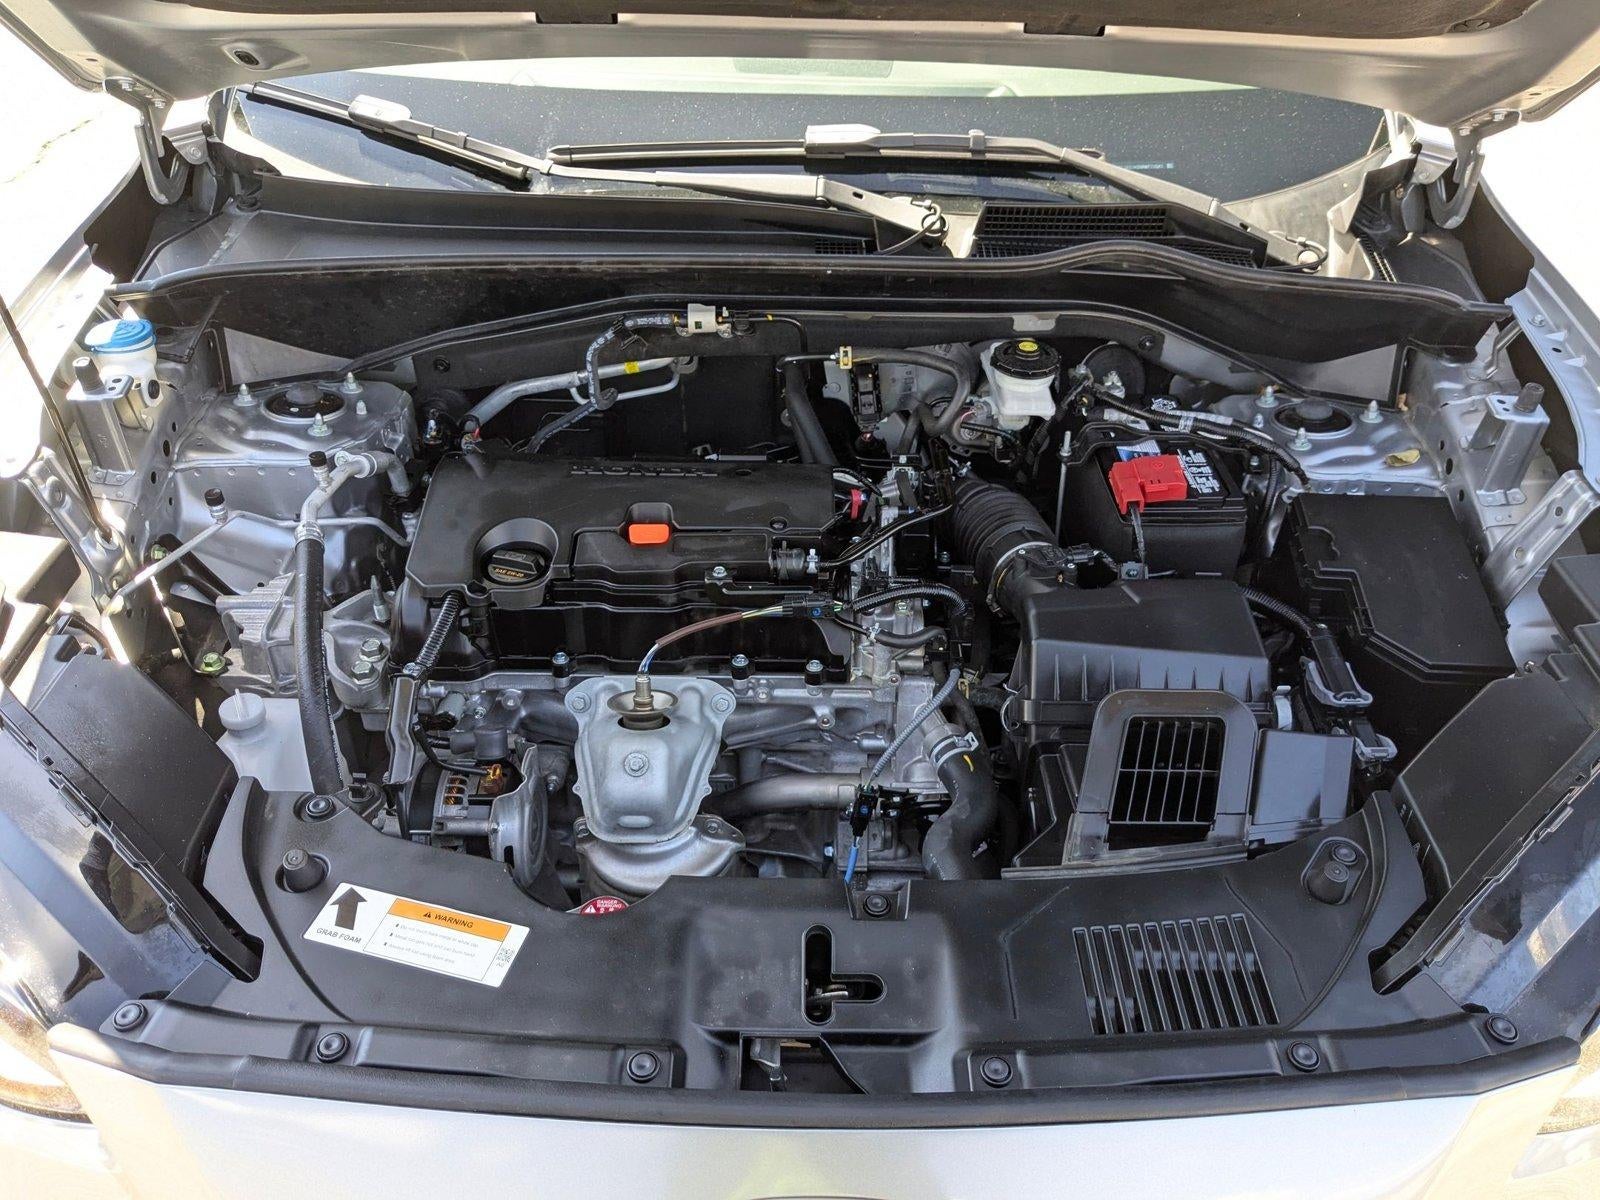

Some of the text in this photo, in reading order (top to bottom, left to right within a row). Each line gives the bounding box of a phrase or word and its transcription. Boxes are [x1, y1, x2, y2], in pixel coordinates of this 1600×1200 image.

[435, 914, 474, 929] WARNING
[317, 927, 362, 944] GRAB FOAM
